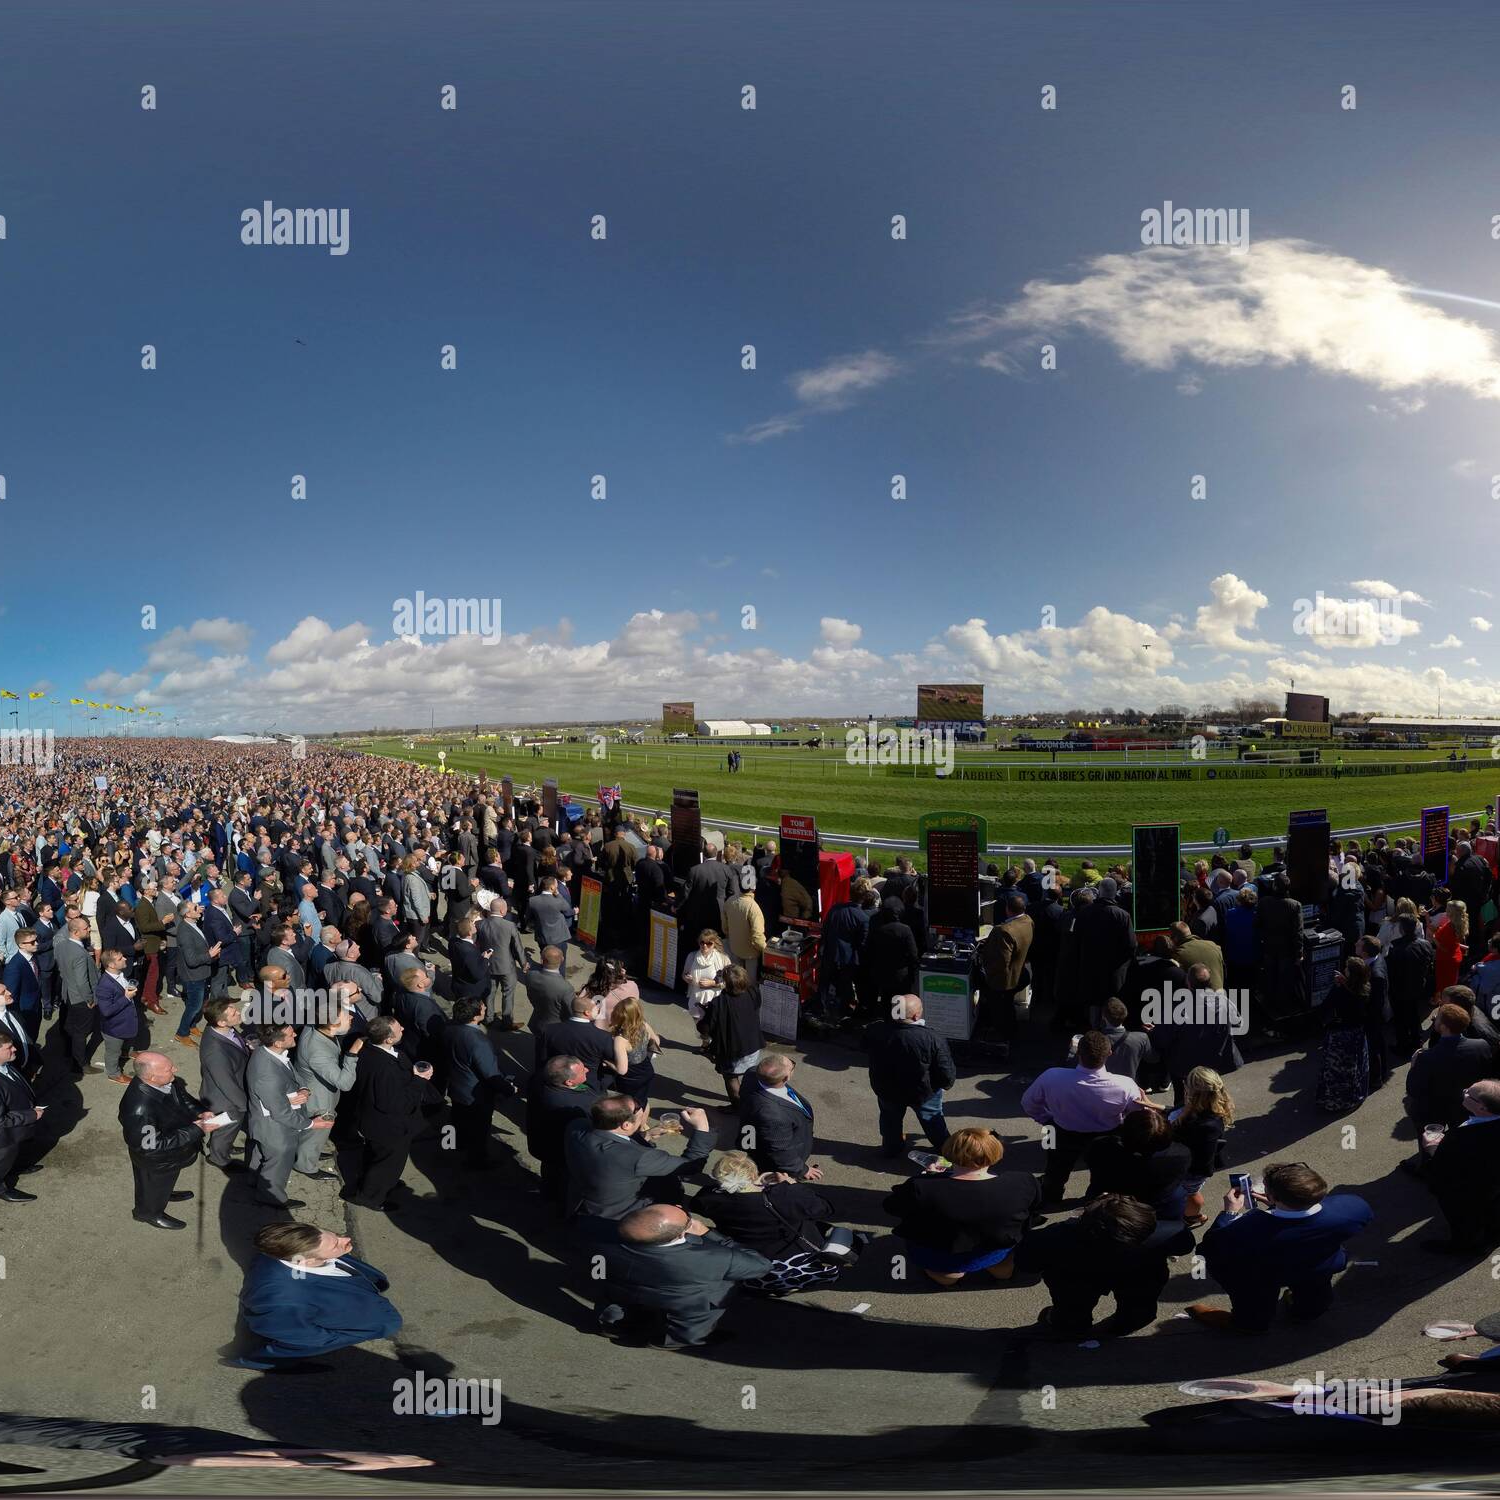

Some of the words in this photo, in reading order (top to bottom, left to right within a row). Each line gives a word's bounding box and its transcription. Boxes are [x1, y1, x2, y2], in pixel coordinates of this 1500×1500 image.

[1019, 769, 1035, 781] IT'S
[1038, 769, 1084, 781] CRABBIE'S
[1087, 770, 1121, 781] GRAND
[1123, 769, 1170, 780] NATIONAL
[1171, 769, 1192, 780] TIME
[790, 819, 805, 827] TOM
[782, 828, 814, 838] WEBSTER
